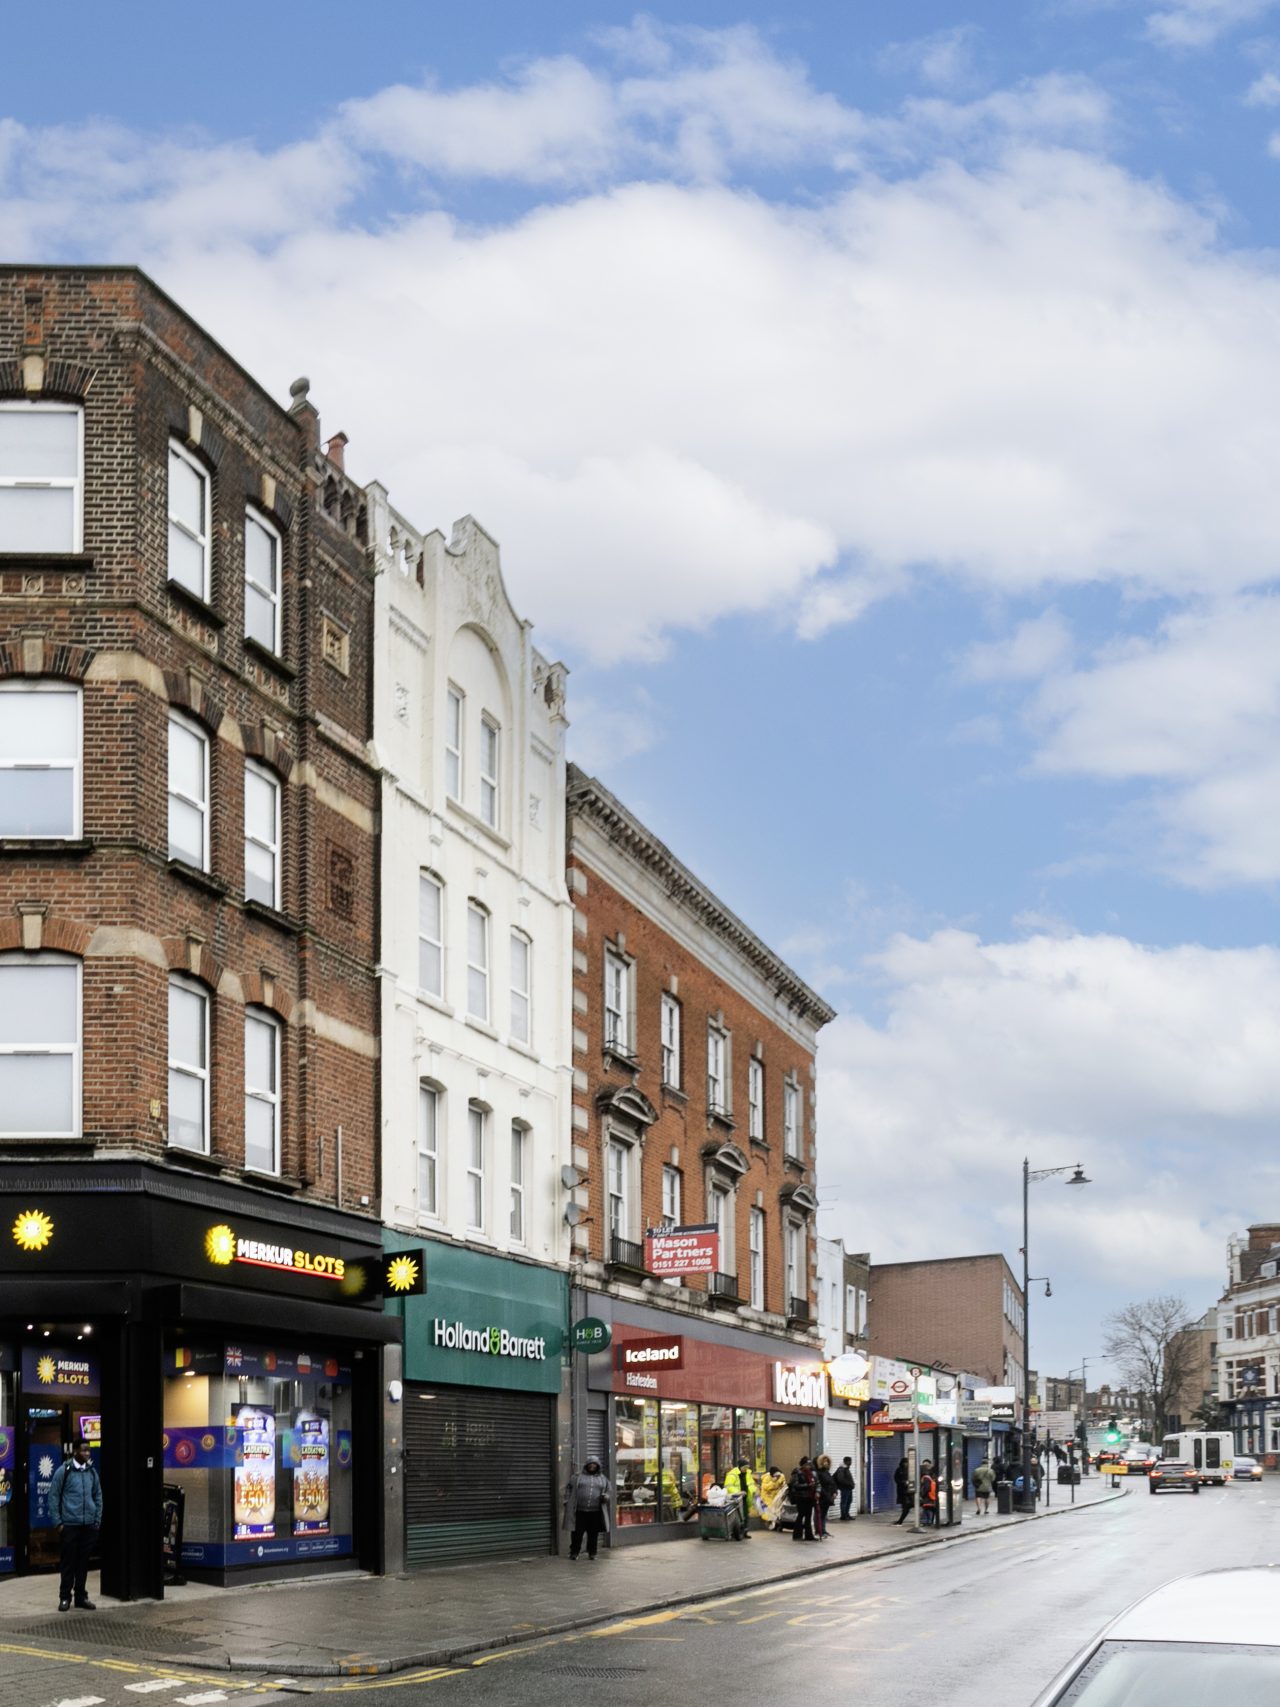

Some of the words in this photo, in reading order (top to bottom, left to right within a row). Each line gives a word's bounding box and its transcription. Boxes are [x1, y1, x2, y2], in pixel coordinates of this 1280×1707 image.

[652, 1237, 698, 1249] Mason
[237, 1239, 293, 1266] MERKUR
[294, 1250, 345, 1275] SLOTS
[652, 1247, 713, 1260] Partners
[652, 1261, 672, 1269] 0151
[626, 1345, 679, 1363] Iceland
[57, 1360, 89, 1372] MERKUR
[57, 1373, 90, 1386] SLOTS
[626, 1372, 657, 1389] Harlesden
[776, 1361, 825, 1409] Iceland
[240, 1490, 271, 1508] £500
[298, 1489, 325, 1506] £500
